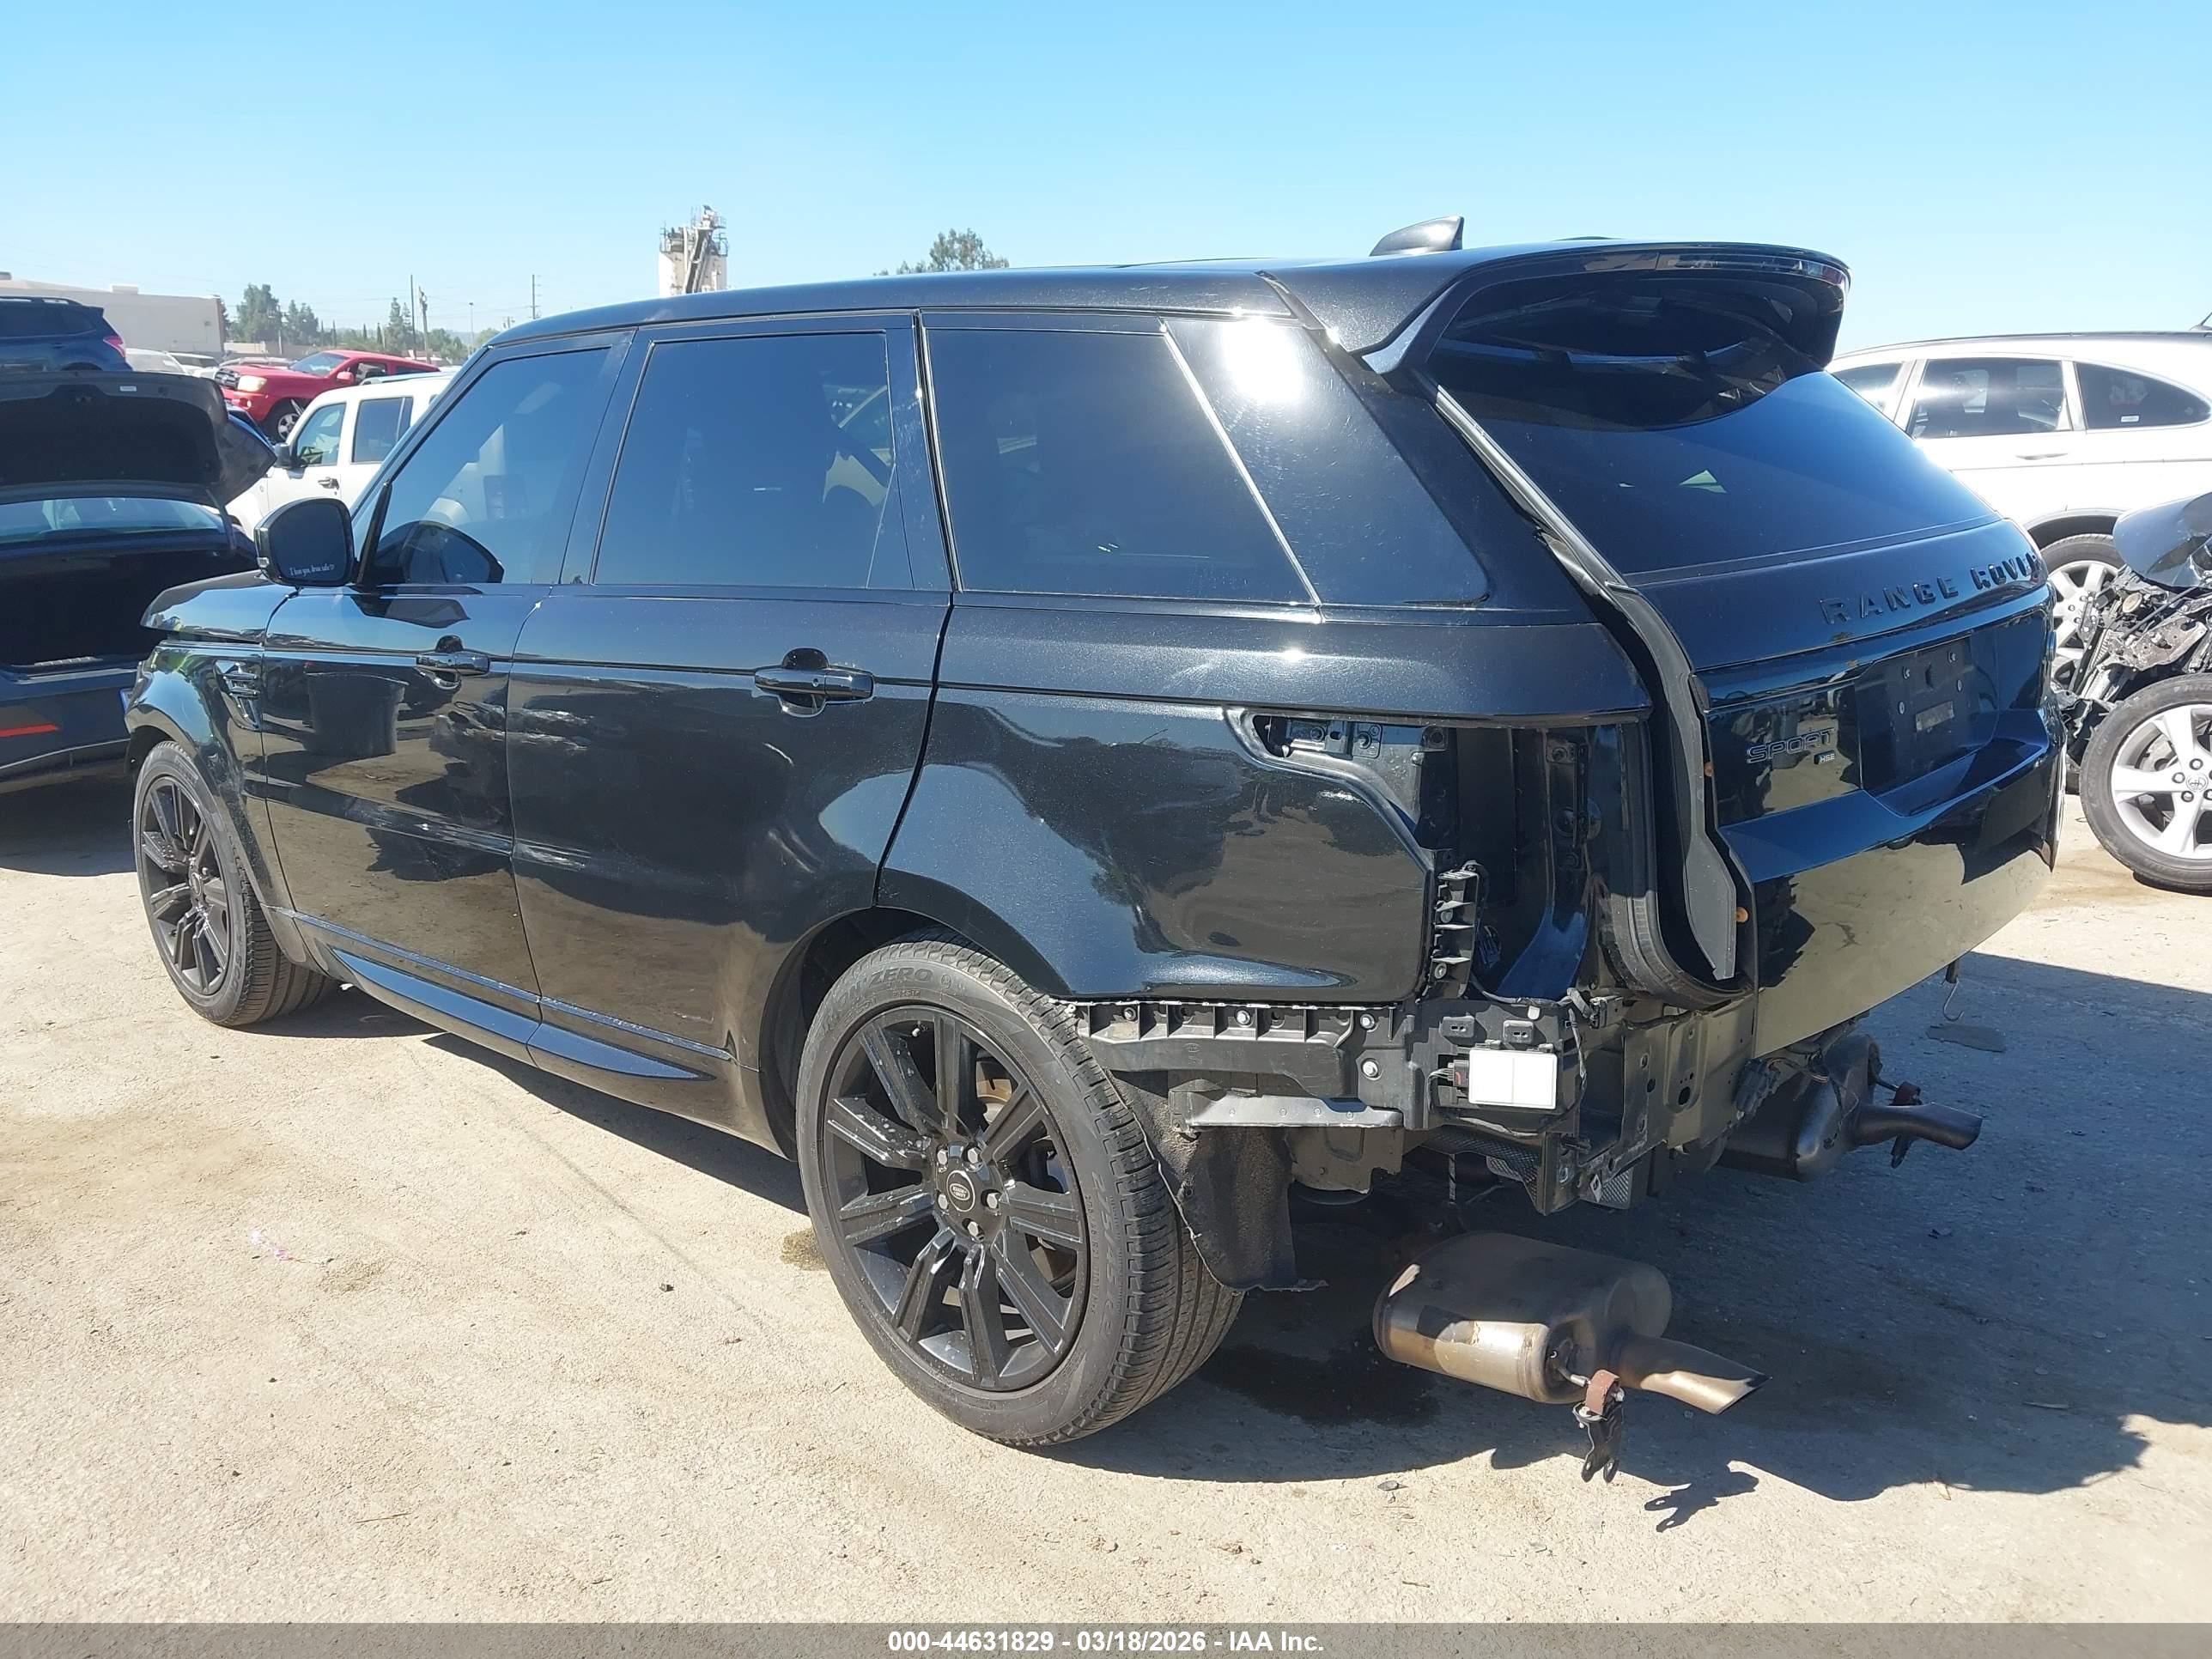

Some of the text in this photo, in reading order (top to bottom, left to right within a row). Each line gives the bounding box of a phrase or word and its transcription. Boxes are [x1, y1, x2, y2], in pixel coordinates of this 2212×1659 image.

[1819, 576, 1959, 625] RANGE
[1746, 726, 1835, 764] SPORT
[1820, 753, 1835, 763] HSE
[869, 967, 934, 988] ZERO
